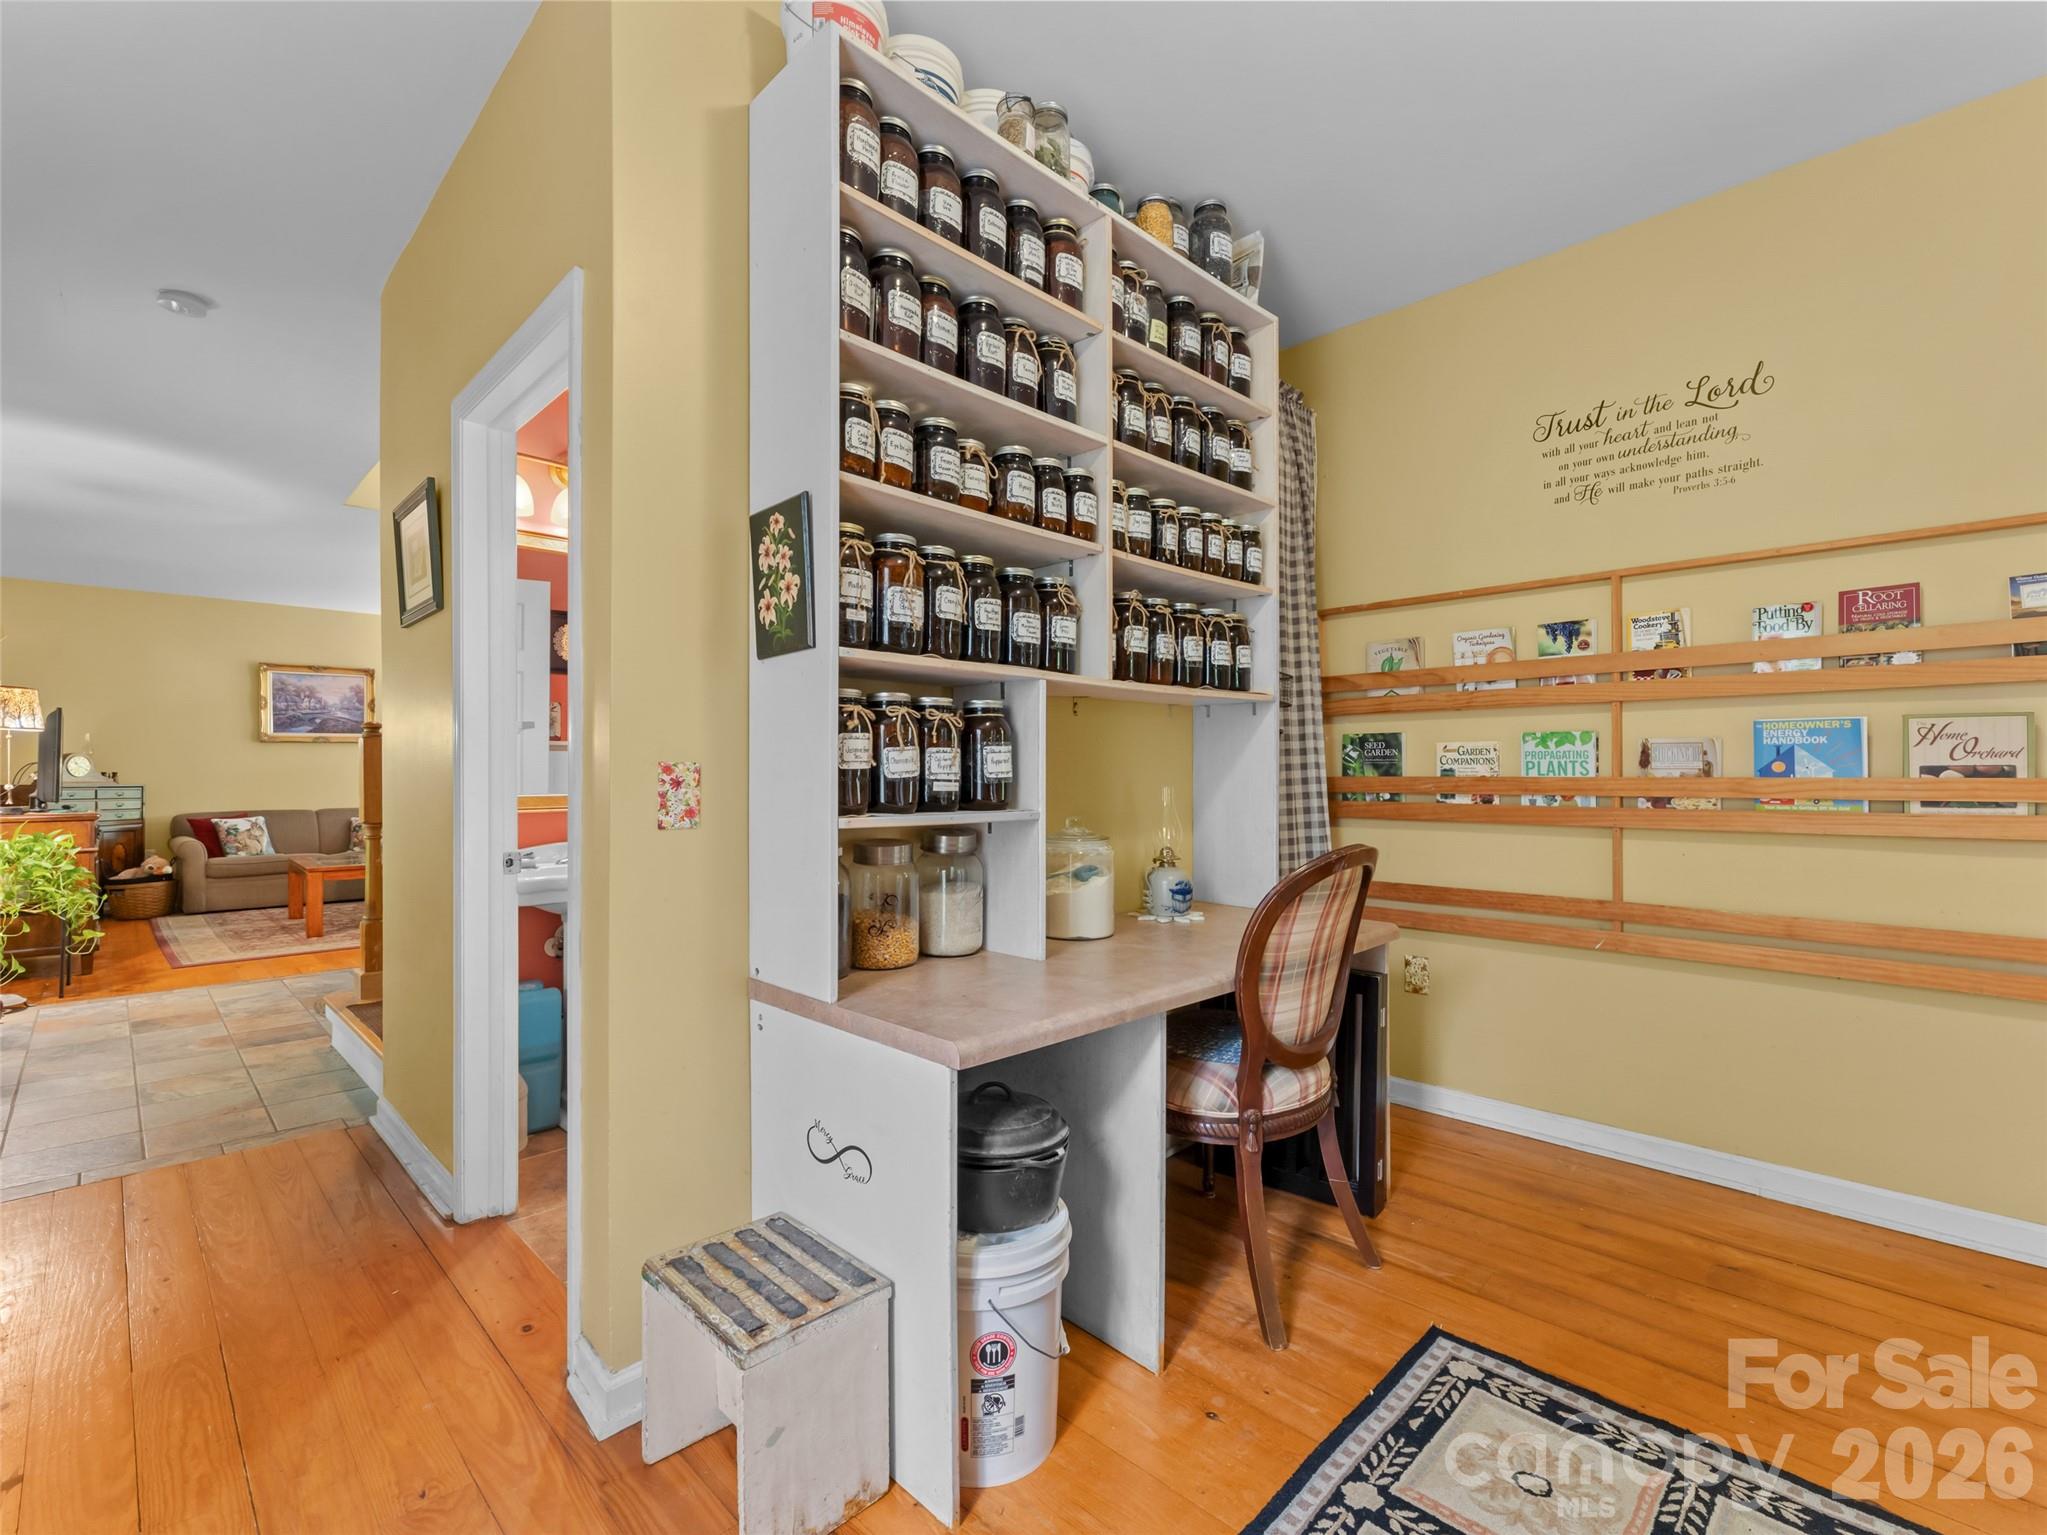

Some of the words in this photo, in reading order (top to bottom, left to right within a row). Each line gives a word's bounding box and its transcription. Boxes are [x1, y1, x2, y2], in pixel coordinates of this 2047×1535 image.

[1533, 400, 1617, 442] Trust
[1617, 407, 1637, 422] in
[1633, 394, 1674, 415] the
[1684, 360, 1775, 409] Lord
[1542, 446, 1560, 459] with
[1564, 443, 1576, 455] all
[1579, 440, 1600, 455] your
[1600, 420, 1650, 446] heart
[1653, 421, 1672, 435] and
[1676, 414, 1697, 430] lean
[1702, 413, 1719, 425] not
[1543, 480, 1552, 490] in
[1555, 476, 1566, 488] all
[1570, 474, 1590, 488] your
[1594, 468, 1616, 481] ways
[1619, 455, 1683, 475] acknowledge
[1686, 450, 1710, 462] him.
[1558, 463, 1570, 472] on
[1572, 458, 1593, 472] your
[1596, 453, 1615, 463] own
[1554, 492, 1570, 505] and
[1574, 480, 1604, 506] He
[1608, 481, 1625, 494] will
[1629, 476, 1656, 491] make
[1658, 473, 1681, 488] your
[1685, 467, 1714, 482] paths
[1717, 457, 1764, 474] straight.
[1672, 481, 1711, 495] Proverbs
[1713, 475, 1736, 487] 3:5-6
[1857, 589, 1905, 606] ROOT
[1752, 604, 1805, 621] Putting
[1851, 600, 1908, 614] CELLARING
[1631, 614, 1670, 624] Woodstove
[1633, 621, 1664, 630] Cookery
[1752, 617, 1790, 634] Food
[1790, 615, 1814, 633] By
[1456, 634, 1477, 644] Organic
[1478, 631, 1505, 641] Gardening
[1762, 719, 1852, 730] HOMEOWNER'S
[1763, 728, 1809, 738] ENERGY
[1763, 735, 1829, 745] HANDBOOK
[1913, 721, 1968, 748] Home
[1364, 741, 1386, 750] SEED
[1364, 748, 1399, 757] GARDEN
[1457, 745, 1492, 757] GARDEN
[1949, 736, 2025, 761] Orchard
[1440, 755, 1497, 766] COMPANIONS
[1524, 750, 1590, 761] PROPAGATING
[1525, 760, 1590, 777] PLANTS
